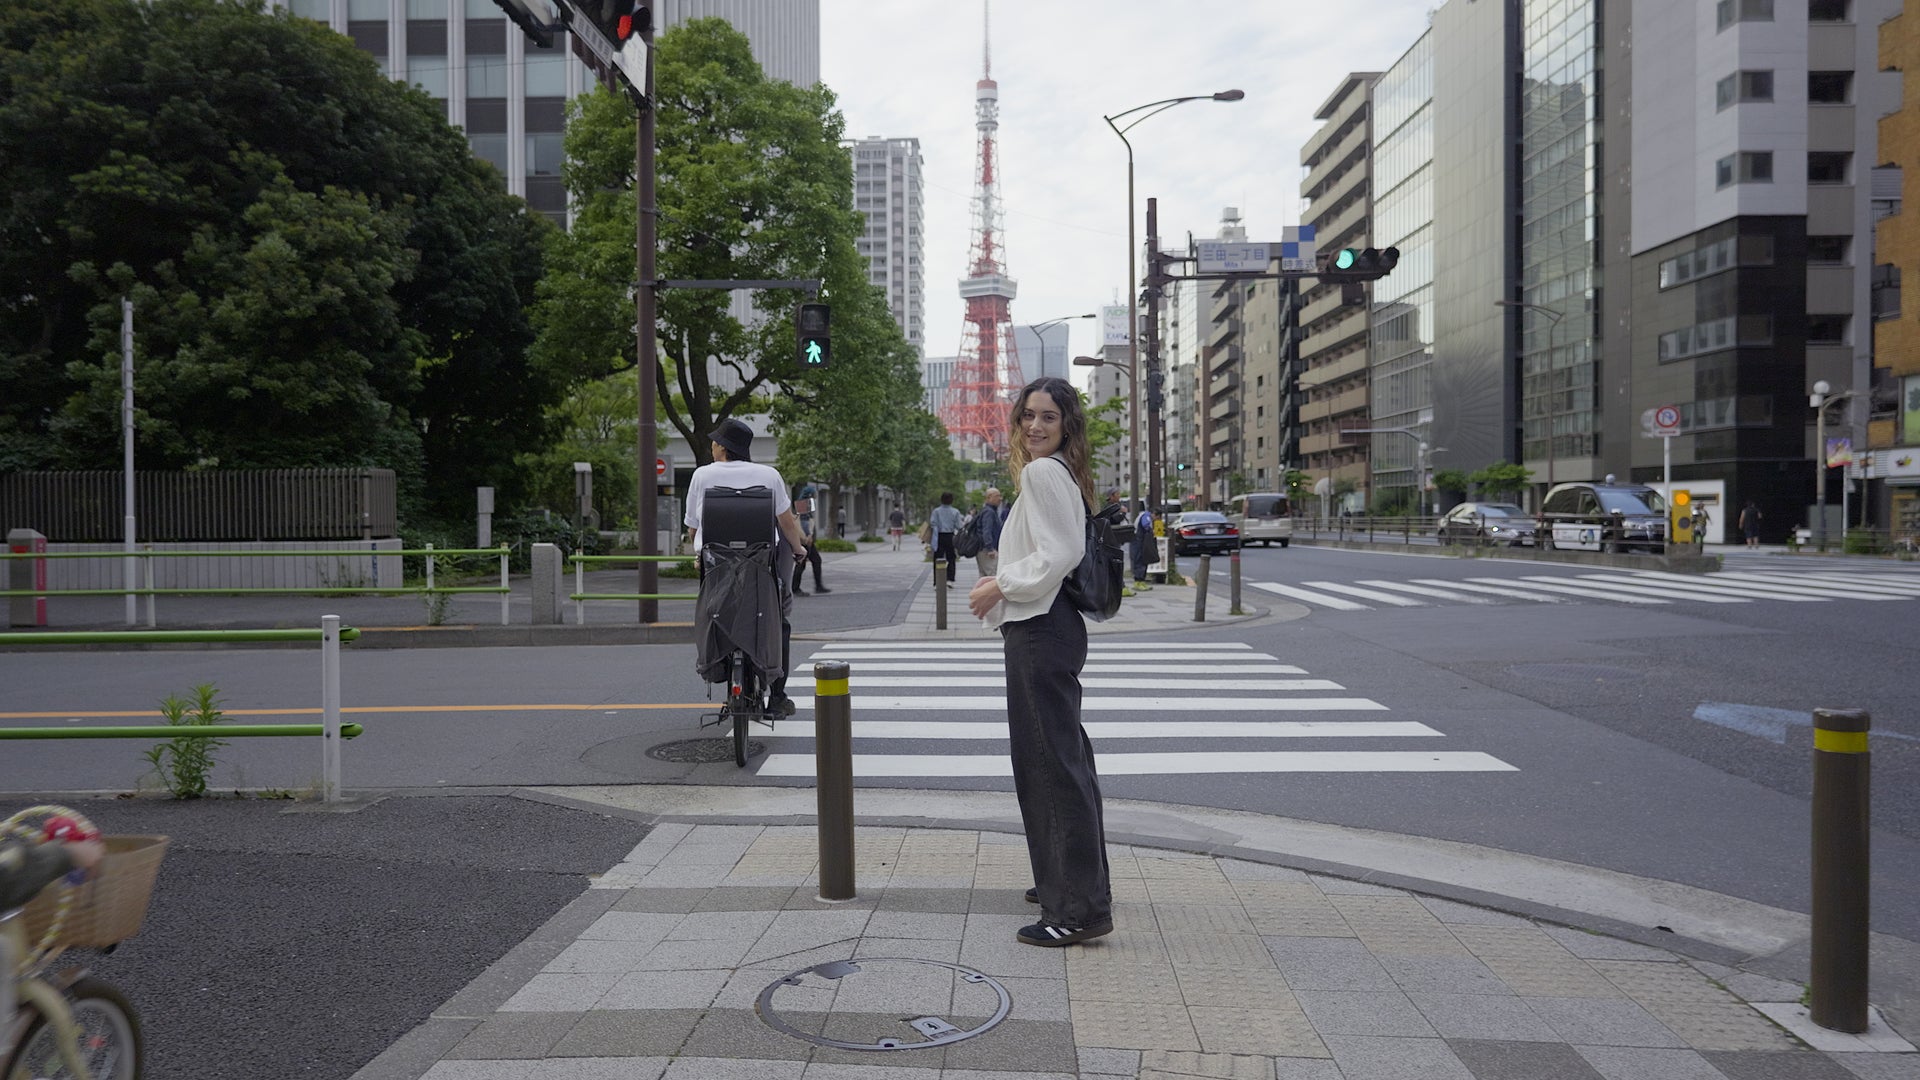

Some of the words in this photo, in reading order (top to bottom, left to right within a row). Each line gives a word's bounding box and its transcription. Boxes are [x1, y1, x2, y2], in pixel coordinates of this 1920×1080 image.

[1203, 248, 1264, 261] 三田一丁目
